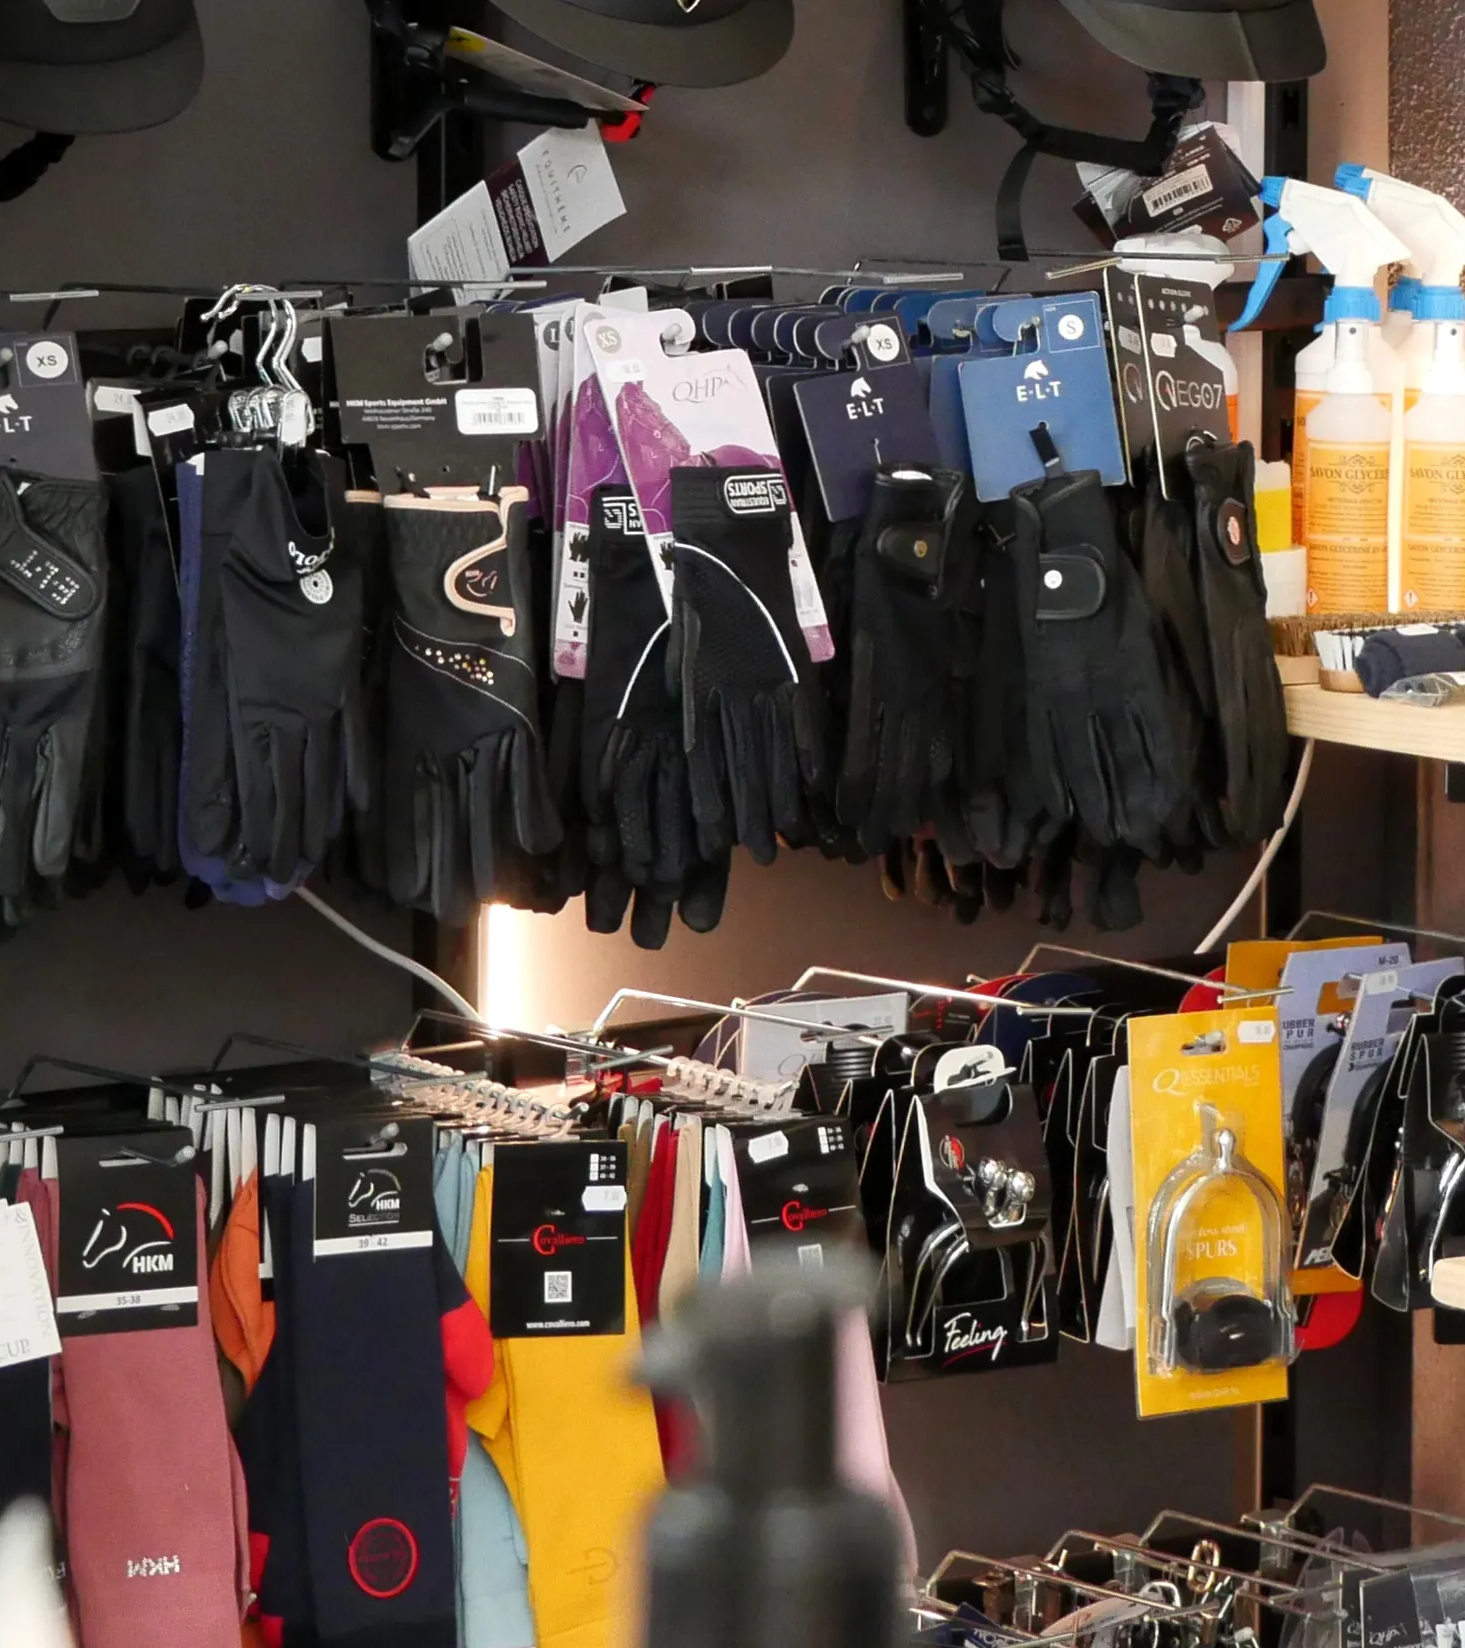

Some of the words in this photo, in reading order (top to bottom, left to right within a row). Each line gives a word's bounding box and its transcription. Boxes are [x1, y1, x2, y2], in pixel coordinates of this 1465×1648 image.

[598, 332, 618, 349] XS
[876, 338, 893, 351] XS
[36, 355, 57, 368] XS
[1176, 379, 1223, 410] EGO7
[1283, 1019, 1315, 1030] UBBER
[376, 1198, 400, 1211] HKM
[132, 1253, 175, 1274] HKM
[944, 1313, 1008, 1361] Feeling
